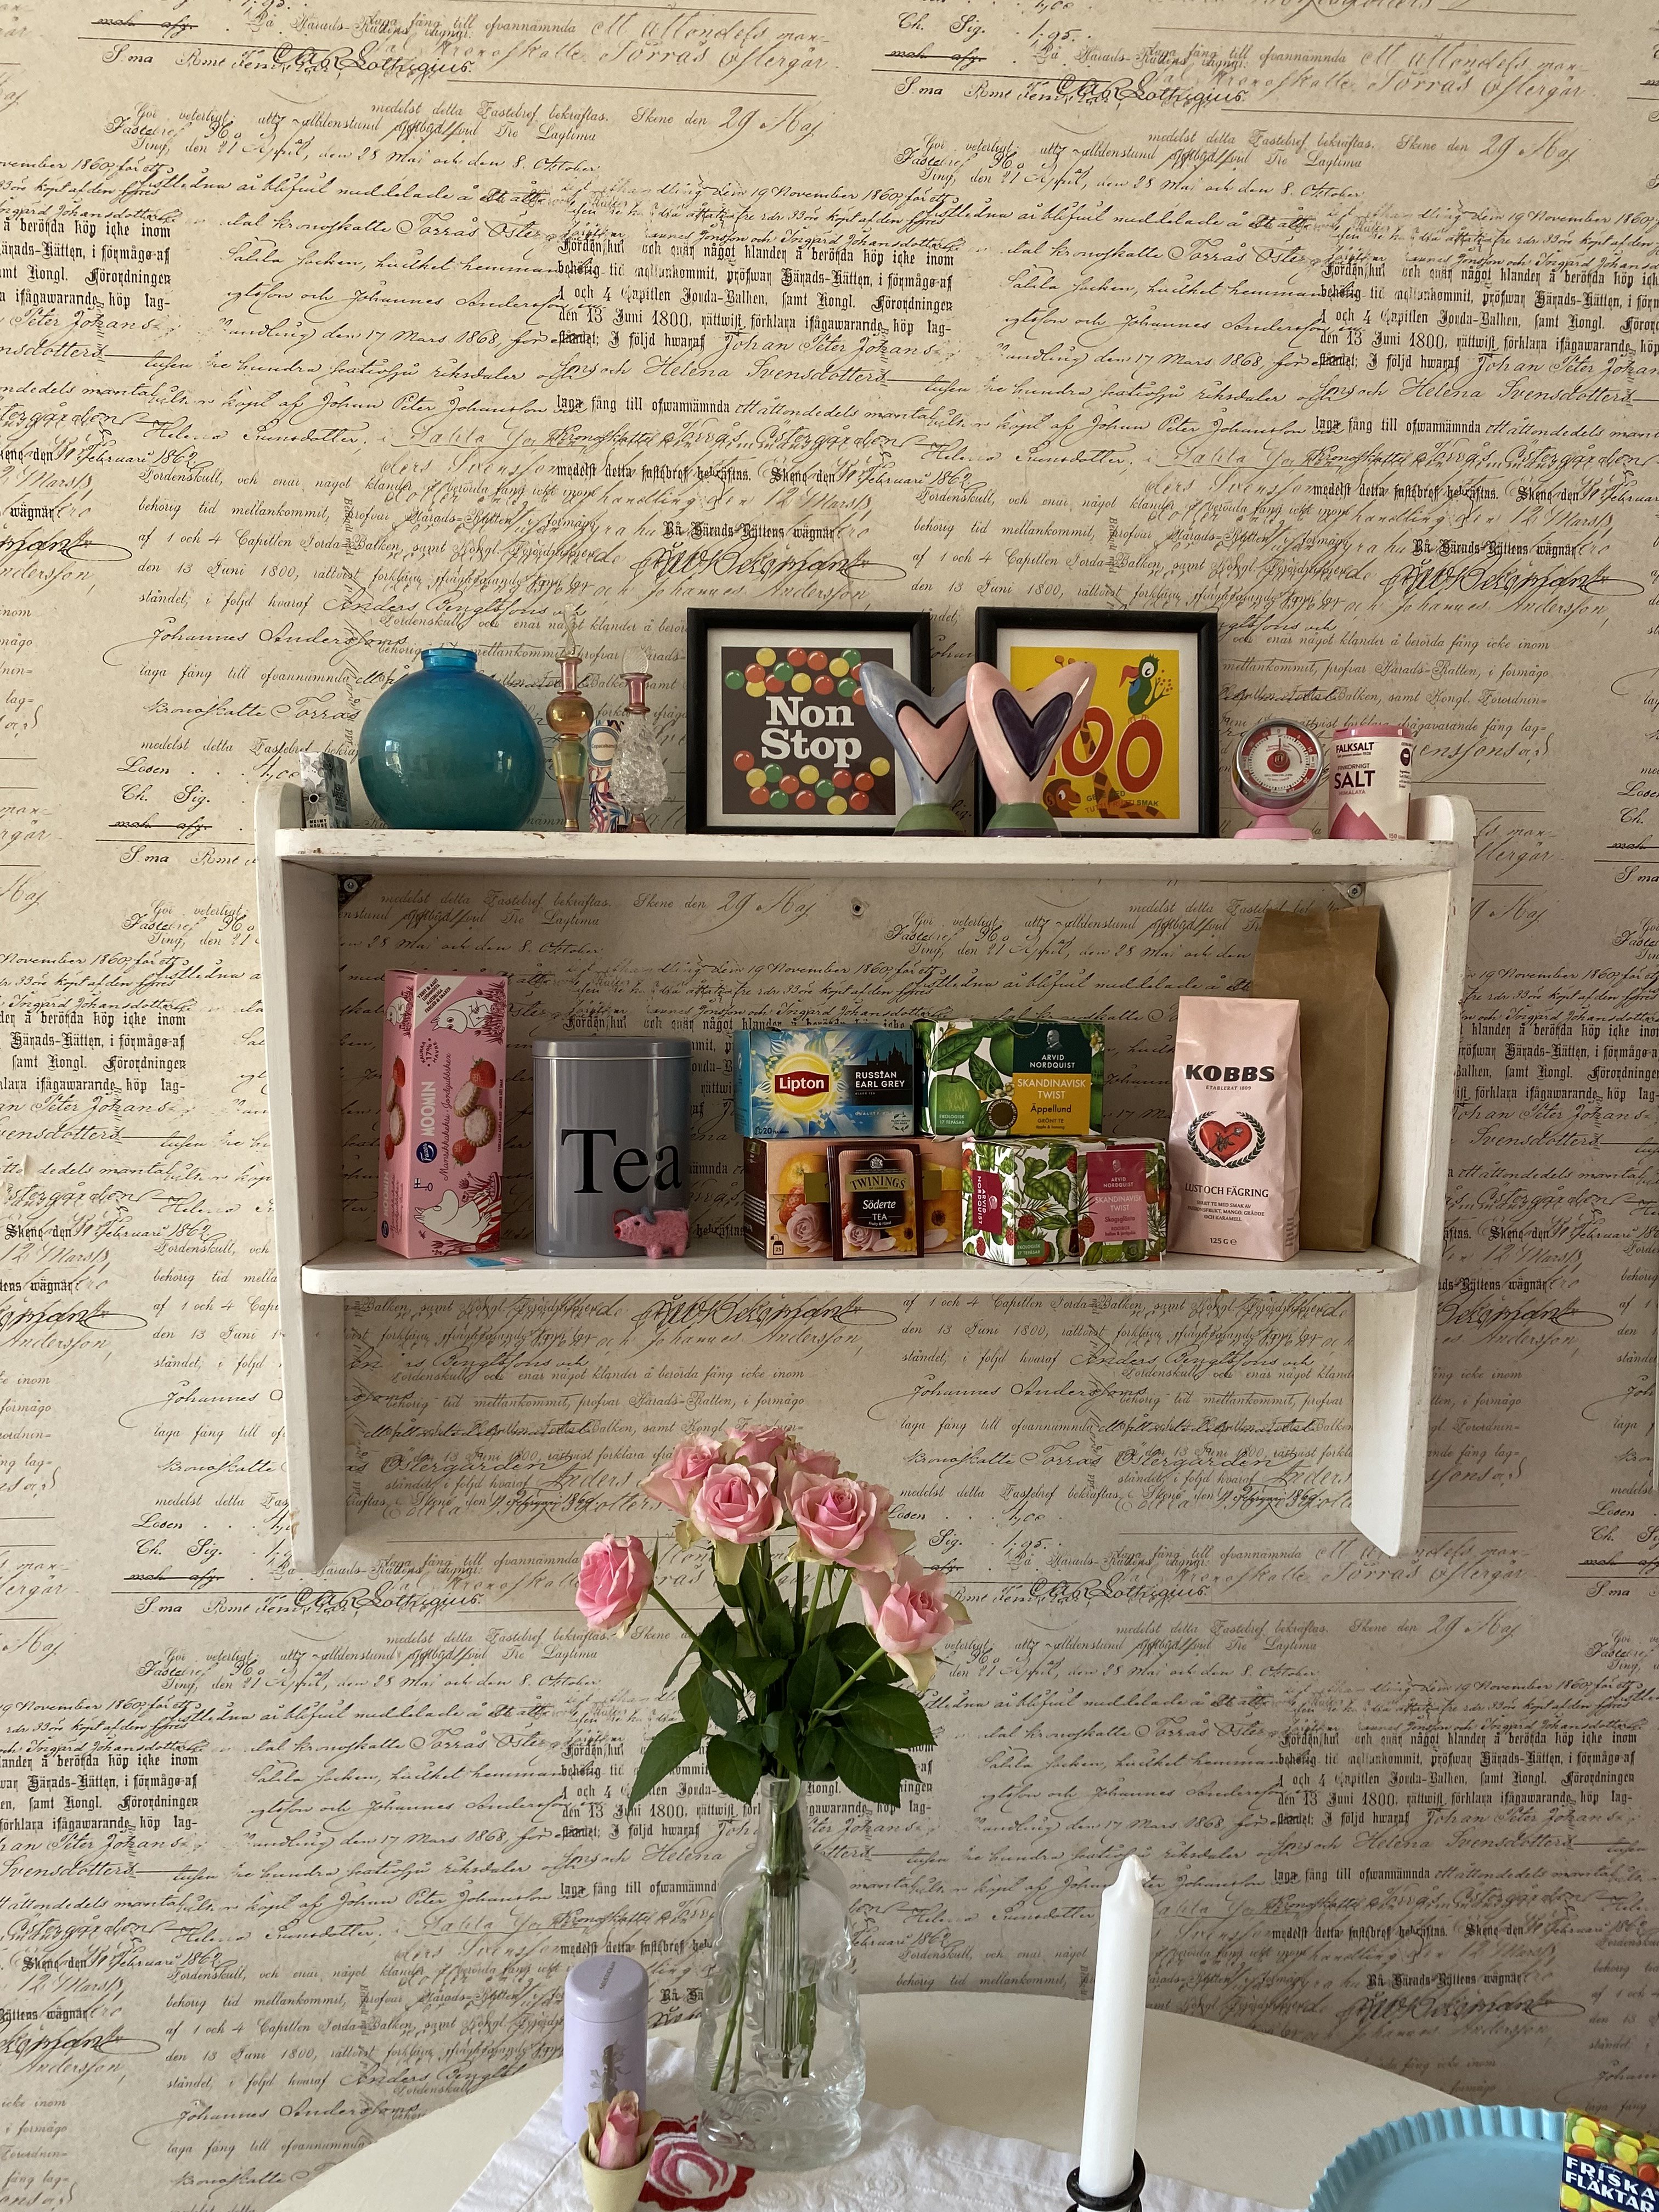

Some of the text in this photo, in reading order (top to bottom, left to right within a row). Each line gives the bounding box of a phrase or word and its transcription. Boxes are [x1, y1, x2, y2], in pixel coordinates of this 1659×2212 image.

[142, 223, 171, 238] inom
[704, 242, 736, 261] något
[864, 249, 883, 266] köp
[927, 250, 953, 266] inom
[109, 292, 130, 309] köp
[603, 286, 611, 301] 4
[559, 308, 577, 321] den
[587, 309, 603, 323] 13
[652, 310, 692, 327] 1800,
[893, 319, 913, 336] köp
[629, 332, 655, 349] följd
[1347, 331, 1362, 345] 13
[1409, 332, 1447, 349] 1800,
[591, 396, 616, 413] fång
[626, 397, 642, 410] till
[1381, 418, 1397, 431] till
[766, 696, 854, 727] Non
[761, 727, 862, 768] Stop
[1047, 706, 1164, 793] OO
[1336, 742, 1374, 753] FALKSALT
[1334, 770, 1375, 789] SALT
[158, 1013, 186, 1026] inom
[855, 1071, 897, 1079] RUSSIAN
[1185, 1064, 1274, 1082] KOBBS
[779, 1076, 825, 1092] Lipton
[855, 1080, 878, 1088] EARL
[1017, 1079, 1086, 1087] SKANDINAVISK
[1038, 1091, 1065, 1099] TWIST
[420, 1081, 436, 1137] MOOMIN
[1030, 1102, 1071, 1115] Äppellund
[561, 1129, 682, 1194] Tea
[850, 1176, 906, 1190] TWININGS
[1185, 1183, 1269, 1198] LUST OCH FÄGRING
[862, 1199, 896, 1209] Söderte
[1095, 1194, 1143, 1204] SKANDINAVISK
[1411, 1733, 1438, 1747] något
[1612, 1732, 1637, 1743] inom
[171, 1754, 198, 1767] inom
[604, 1785, 612, 1799] 4
[1304, 1792, 1318, 1805] 13
[650, 1804, 687, 1818] 1800,
[1336, 1867, 1351, 1880] till
[1566, 2156, 1656, 2202] FRISKA
[1565, 2170, 1655, 2212] FLÄKTAR
